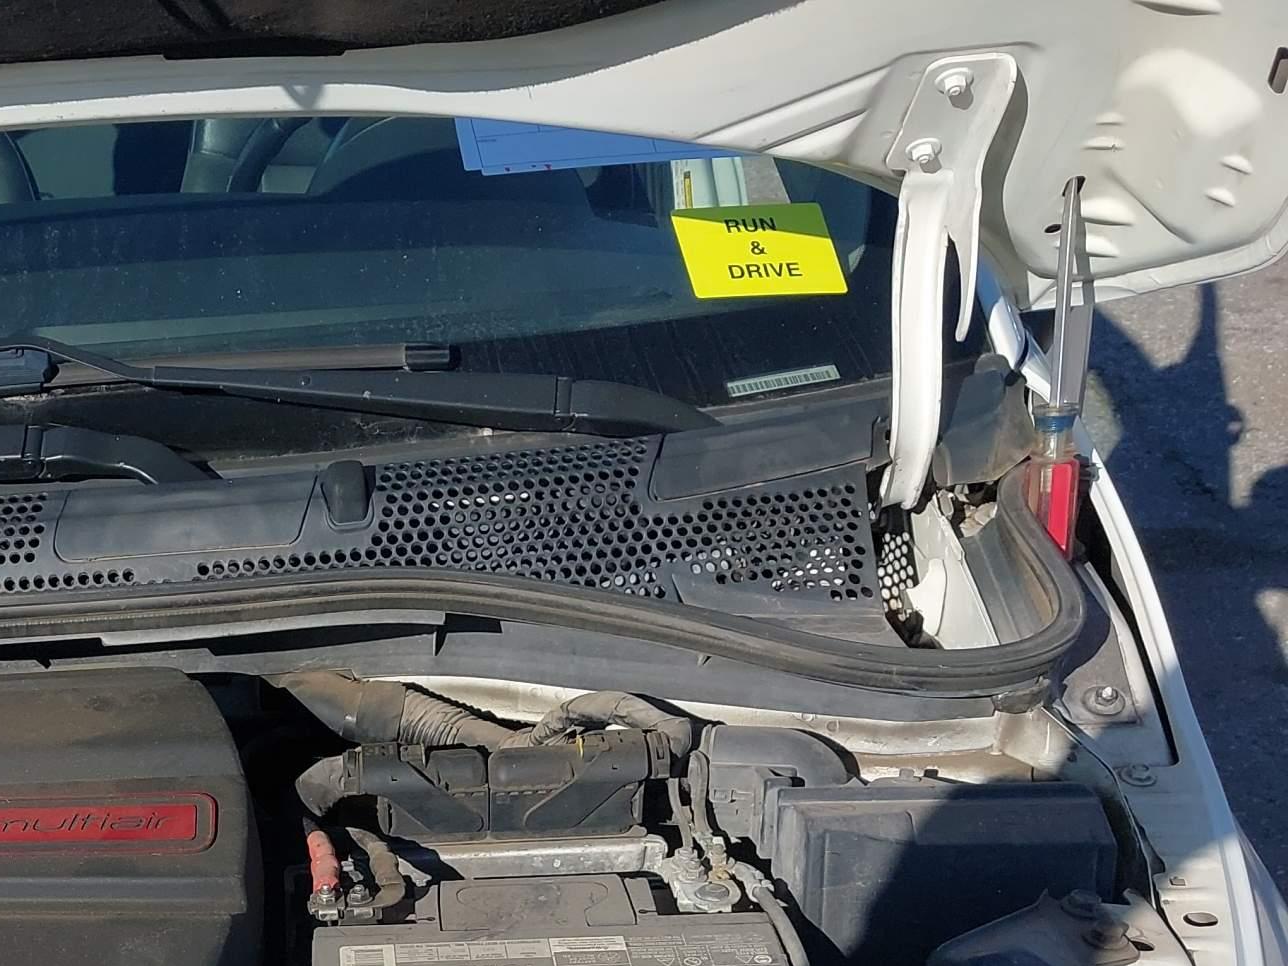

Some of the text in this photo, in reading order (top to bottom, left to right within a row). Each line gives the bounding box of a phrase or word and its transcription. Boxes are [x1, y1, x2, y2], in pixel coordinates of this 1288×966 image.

[723, 216, 777, 234] RUN
[750, 241, 767, 256] &
[728, 262, 803, 280] DRIVE
